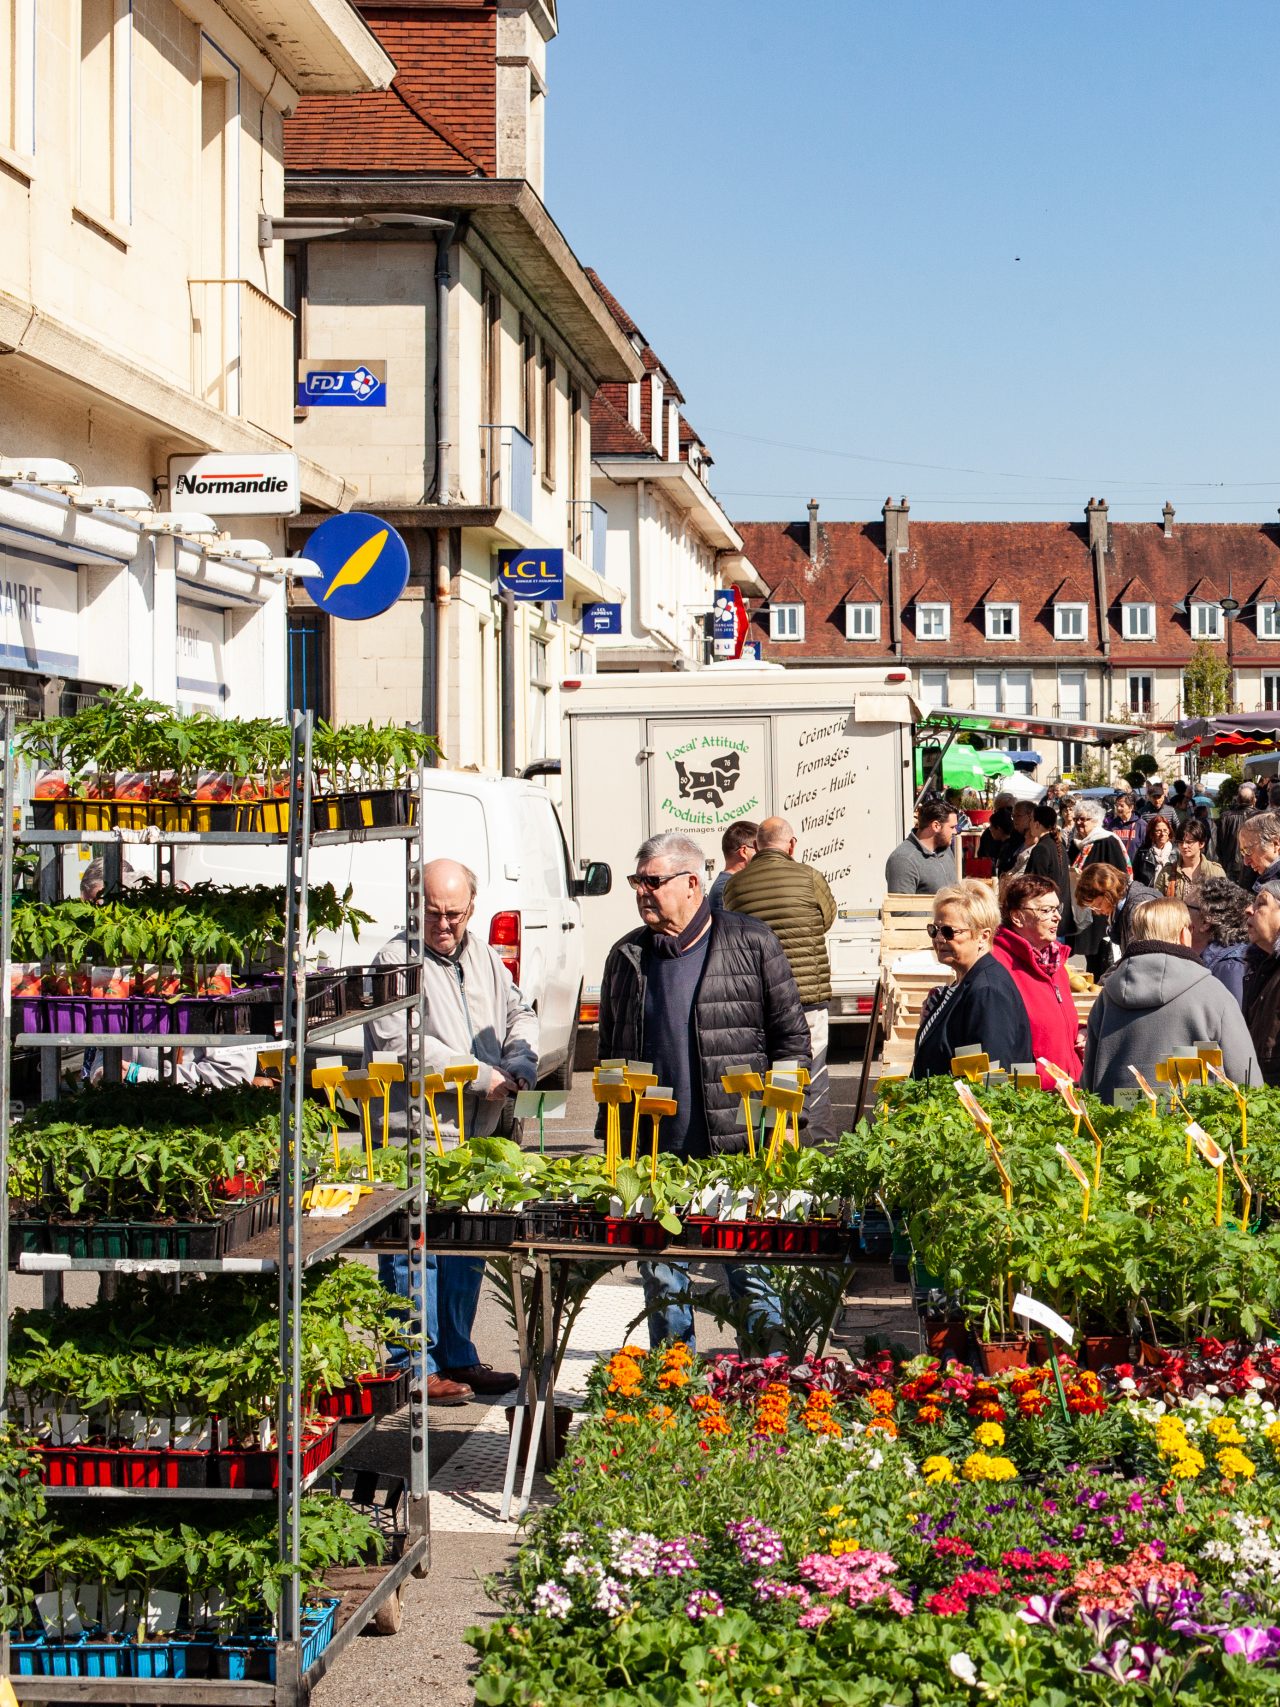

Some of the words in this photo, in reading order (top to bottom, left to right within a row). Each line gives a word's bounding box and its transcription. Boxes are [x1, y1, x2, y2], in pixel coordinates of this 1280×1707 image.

[310, 375, 344, 390] FDJ
[183, 474, 289, 495] Normandie
[503, 561, 556, 578] LCL
[0, 580, 42, 624] AIRIE
[701, 736, 750, 753] Attitude
[796, 746, 850, 778] Fromages
[783, 789, 818, 811] Cidres
[830, 770, 857, 792] Huile
[661, 798, 713, 824] Produits
[715, 796, 759, 823] Locaux
[801, 806, 846, 833] Vinaigre
[801, 838, 845, 864] Biscuits
